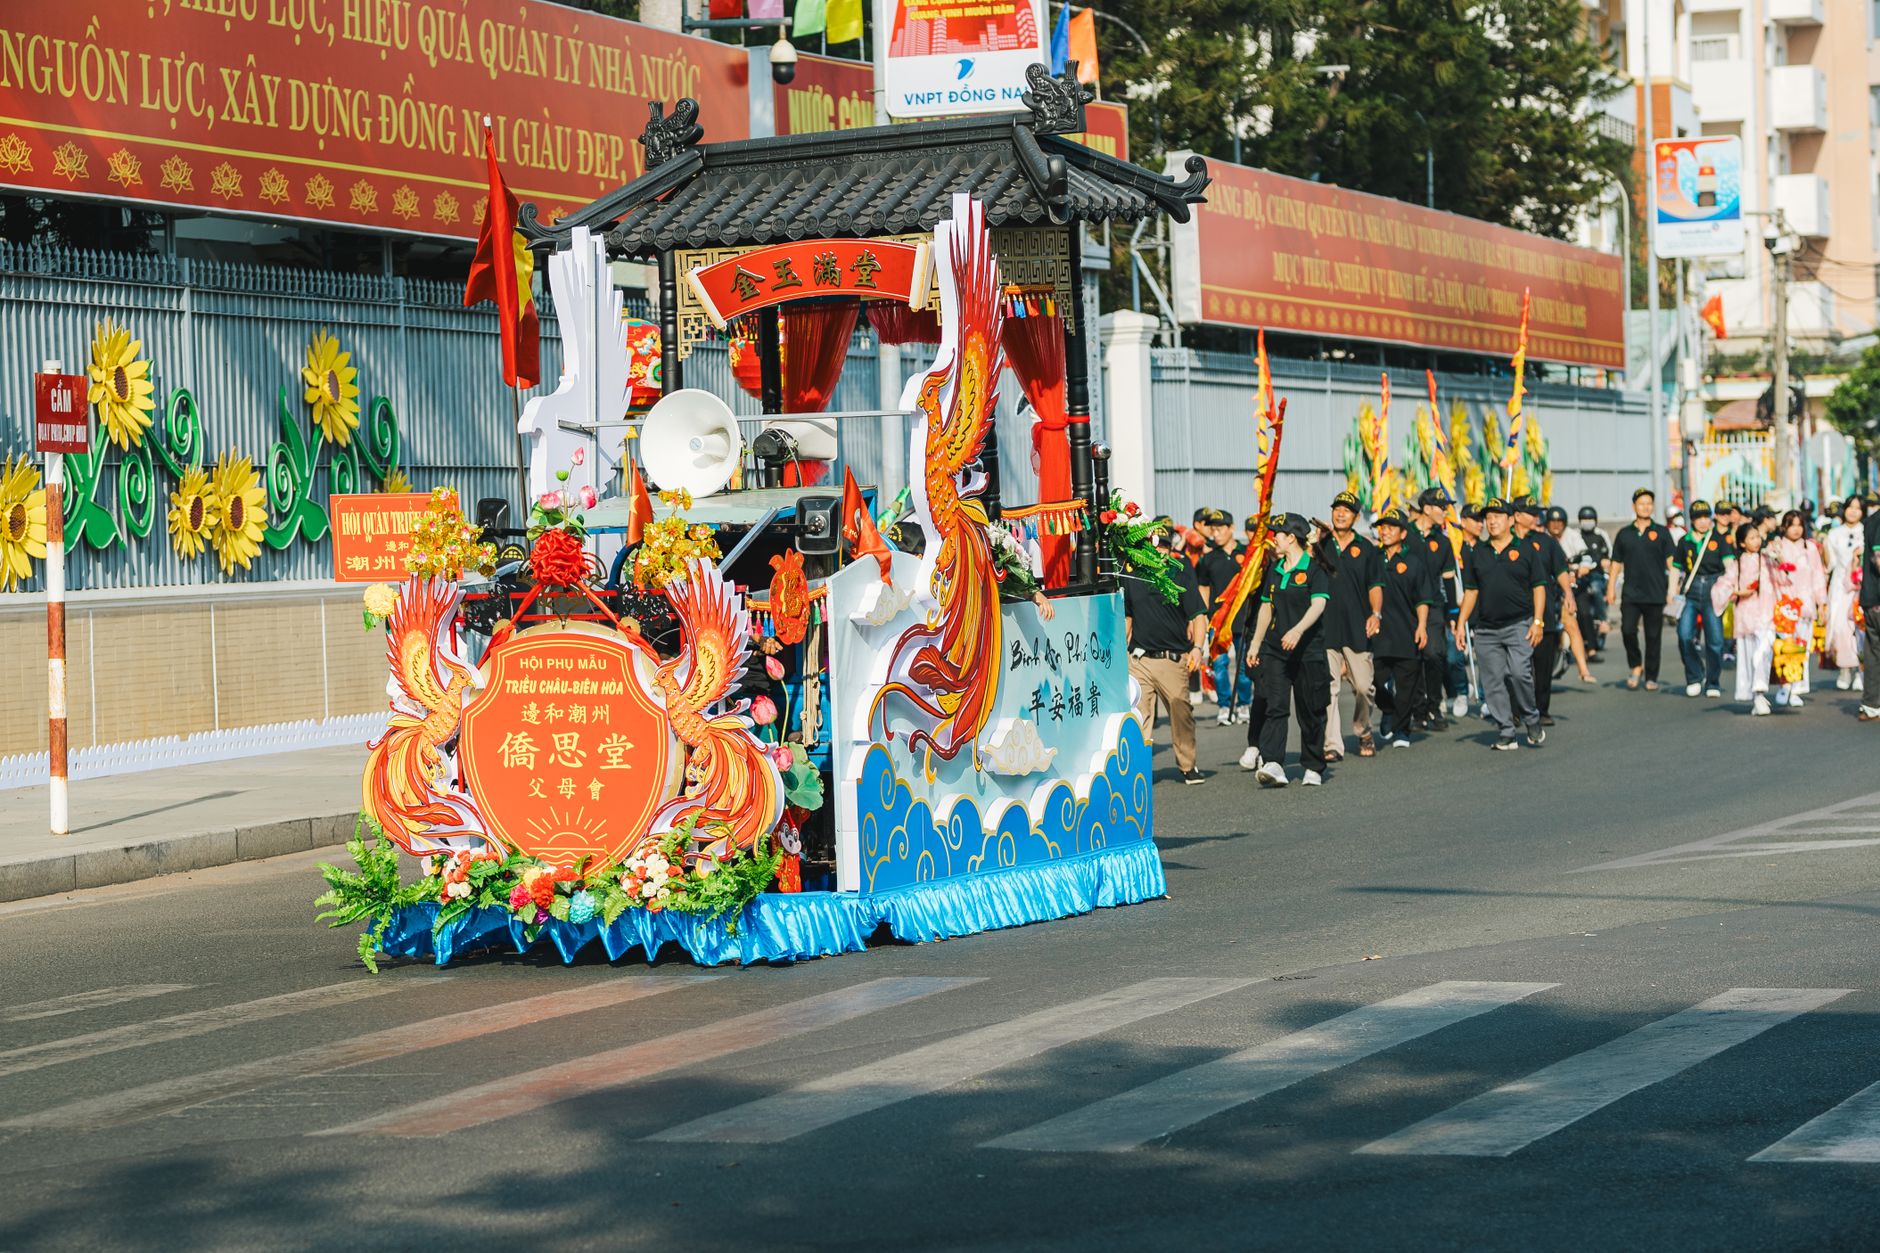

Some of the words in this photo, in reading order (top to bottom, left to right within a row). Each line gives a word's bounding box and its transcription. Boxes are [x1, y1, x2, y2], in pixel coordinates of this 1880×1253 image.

[479, 6, 549, 80] QUẢN
[553, 24, 584, 85] LÝ
[588, 35, 637, 96] NHÀ
[641, 47, 701, 103] NƯỚC
[0, 15, 130, 105] NGUỒN
[139, 51, 216, 130] LỰC,
[219, 54, 281, 128] XÂY
[288, 77, 373, 150] DỰNG
[378, 73, 456, 155] ĐỒNG
[512, 107, 572, 173] GIÀU
[577, 129, 627, 191] ĐẸP,
[904, 91, 943, 105] VNPT
[949, 84, 996, 103] ĐỒNG
[1002, 86, 1028, 99] NA
[51, 379, 72, 413] CẤM
[341, 507, 361, 541] HỘI
[363, 505, 390, 543] QUÁN
[520, 655, 543, 671] HỘI
[547, 658, 574, 671] PHỤ
[578, 654, 607, 669] MẪU
[1090, 632, 1112, 669] Quý
[505, 674, 537, 694] TRIỀU
[601, 678, 624, 695] HÒA
[521, 701, 610, 725] 邊和潮州
[1028, 681, 1101, 725] 平安福貴
[497, 731, 635, 771] 僑思堂
[528, 777, 605, 801] 父母會
